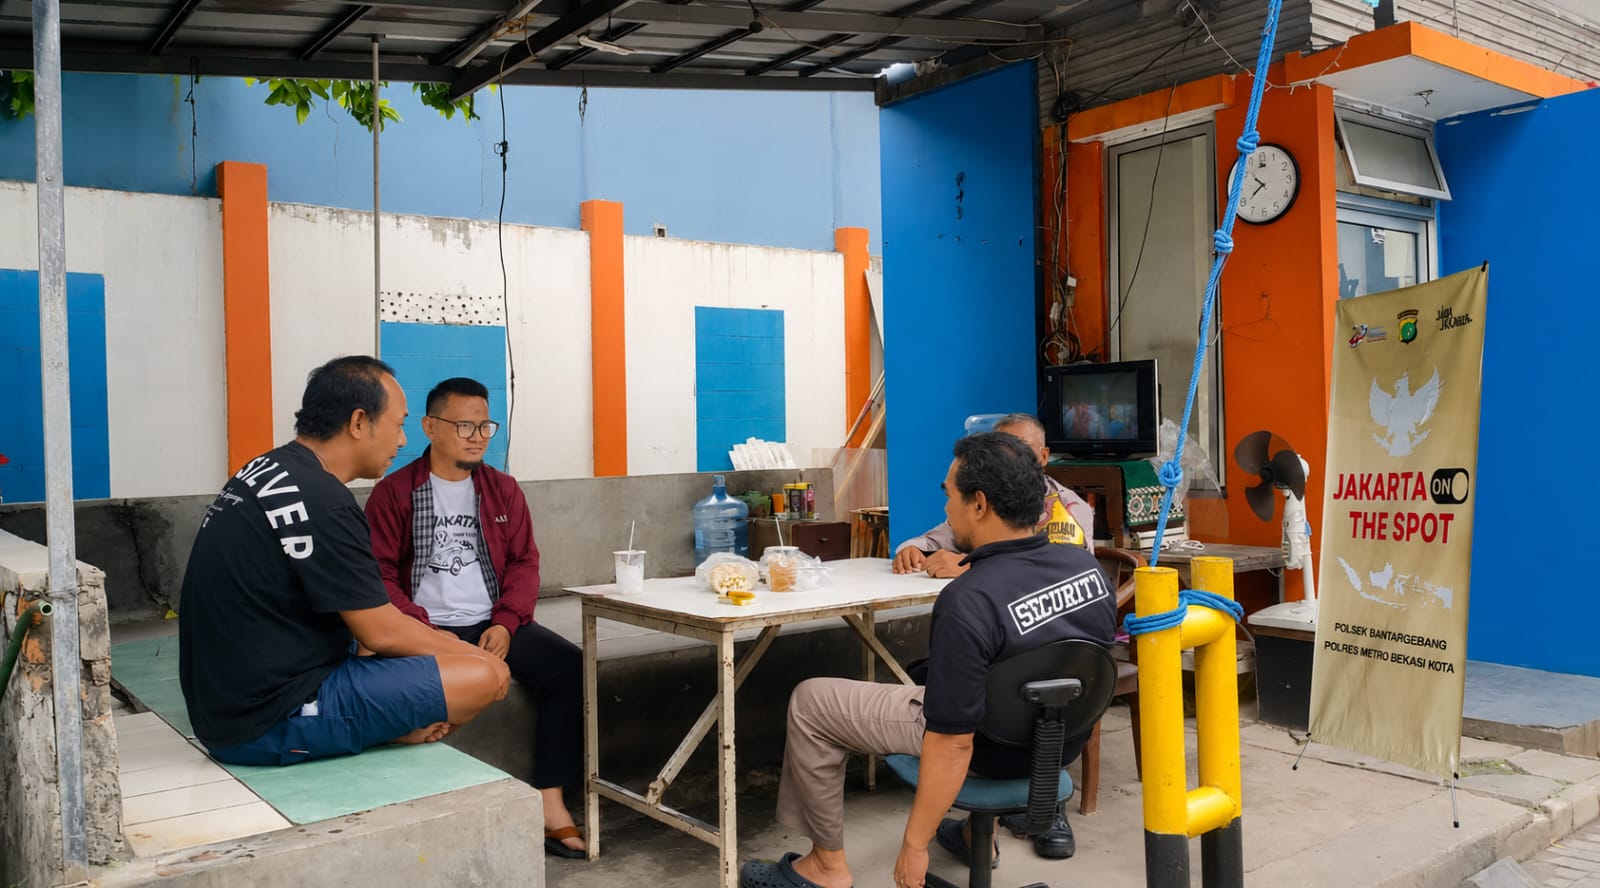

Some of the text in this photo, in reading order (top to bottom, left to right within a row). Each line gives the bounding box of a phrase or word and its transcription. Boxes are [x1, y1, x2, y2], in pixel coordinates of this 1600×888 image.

[1281, 161, 1288, 171] 2
[1286, 175, 1292, 184] 3
[1283, 190, 1289, 198] 4
[1240, 197, 1247, 207] 8
[1273, 201, 1279, 212] 5
[1250, 206, 1255, 216] 7
[1261, 208, 1268, 217] 6
[1333, 471, 1451, 501] JAKARTA ON
[235, 456, 314, 560] SILVER
[1349, 511, 1455, 544] THE SPOT
[1014, 573, 1103, 628] SECURITY
[1334, 622, 1447, 650] POLSEK BANTARGEBANG
[1324, 641, 1455, 674] POLRES METRO BEKASI KOTA
